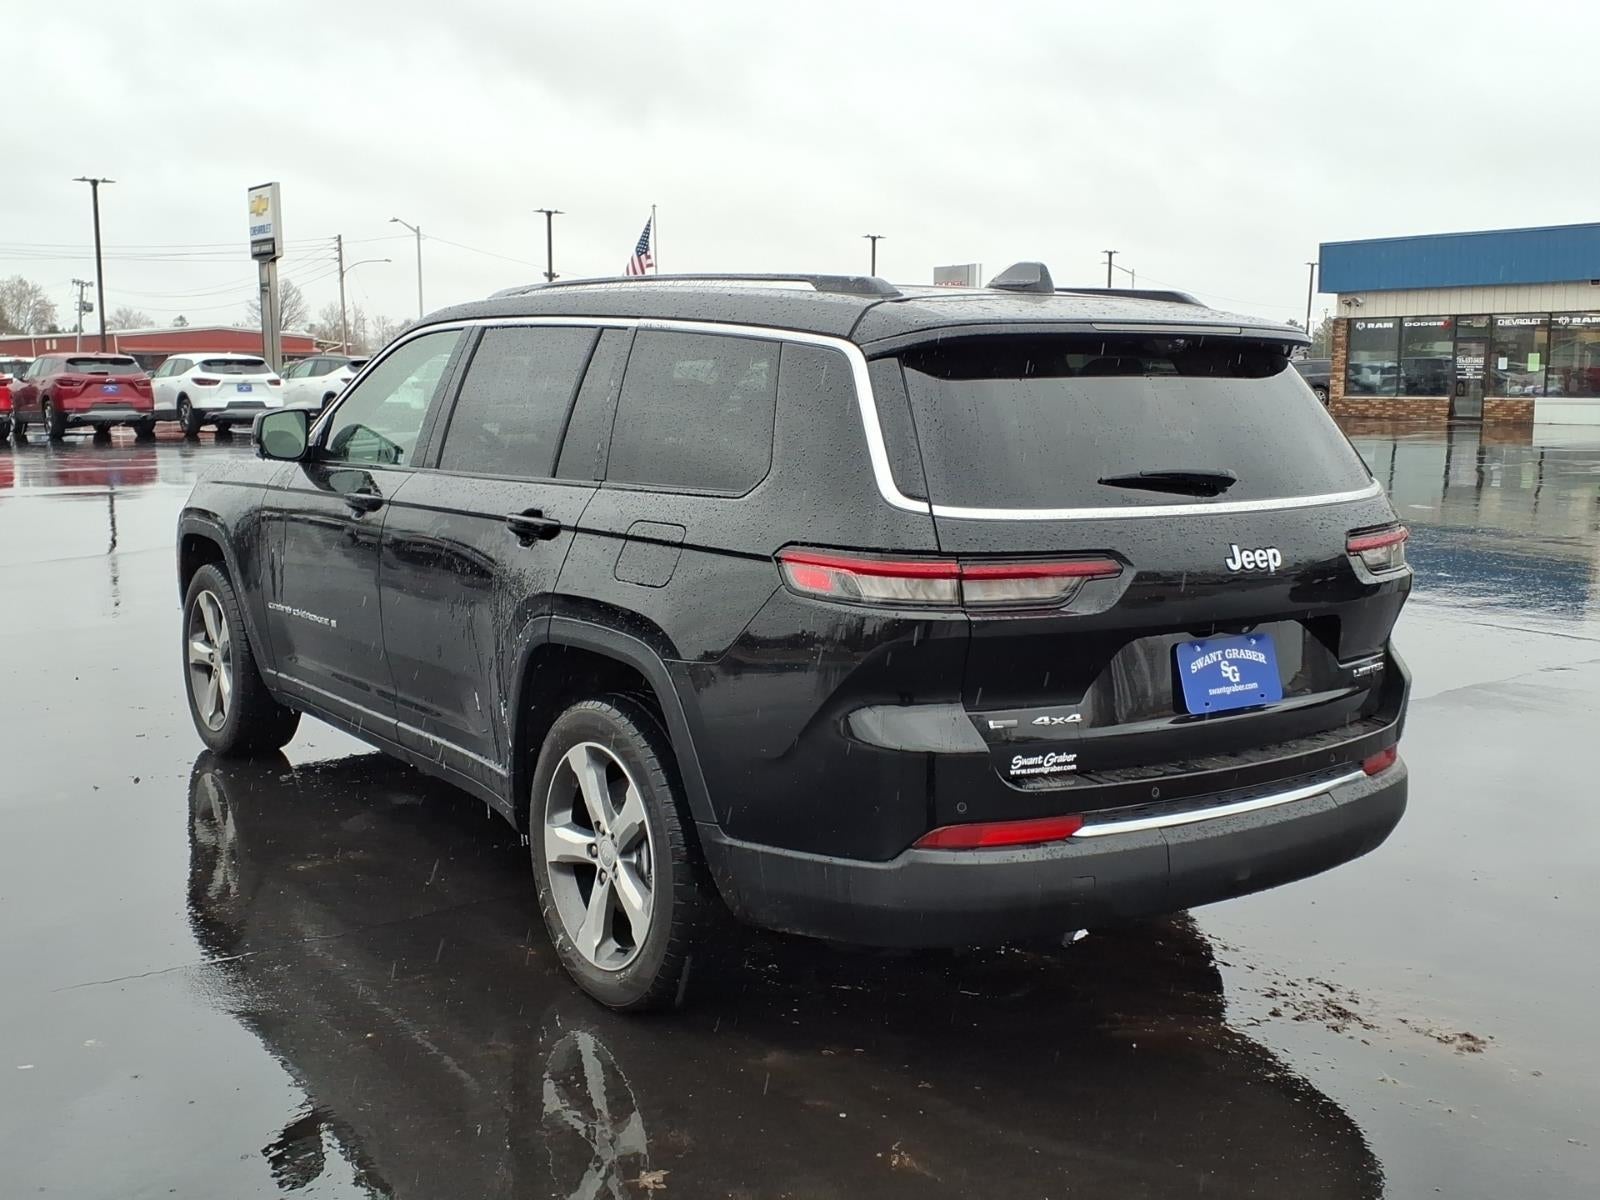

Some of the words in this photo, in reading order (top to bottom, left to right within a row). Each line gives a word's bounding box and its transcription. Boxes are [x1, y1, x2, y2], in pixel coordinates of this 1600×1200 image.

[1497, 318, 1542, 326] CHEVROLET
[1225, 544, 1282, 573] Jeep
[1190, 650, 1223, 674] SWANT
[1225, 648, 1267, 665] GRABER
[1208, 682, 1259, 696] swantgraber.com
[1031, 713, 1083, 726] 4x4
[1011, 755, 1043, 770] Swant
[1043, 752, 1077, 767] Graber
[1009, 764, 1077, 776] www.swantgraber.com
